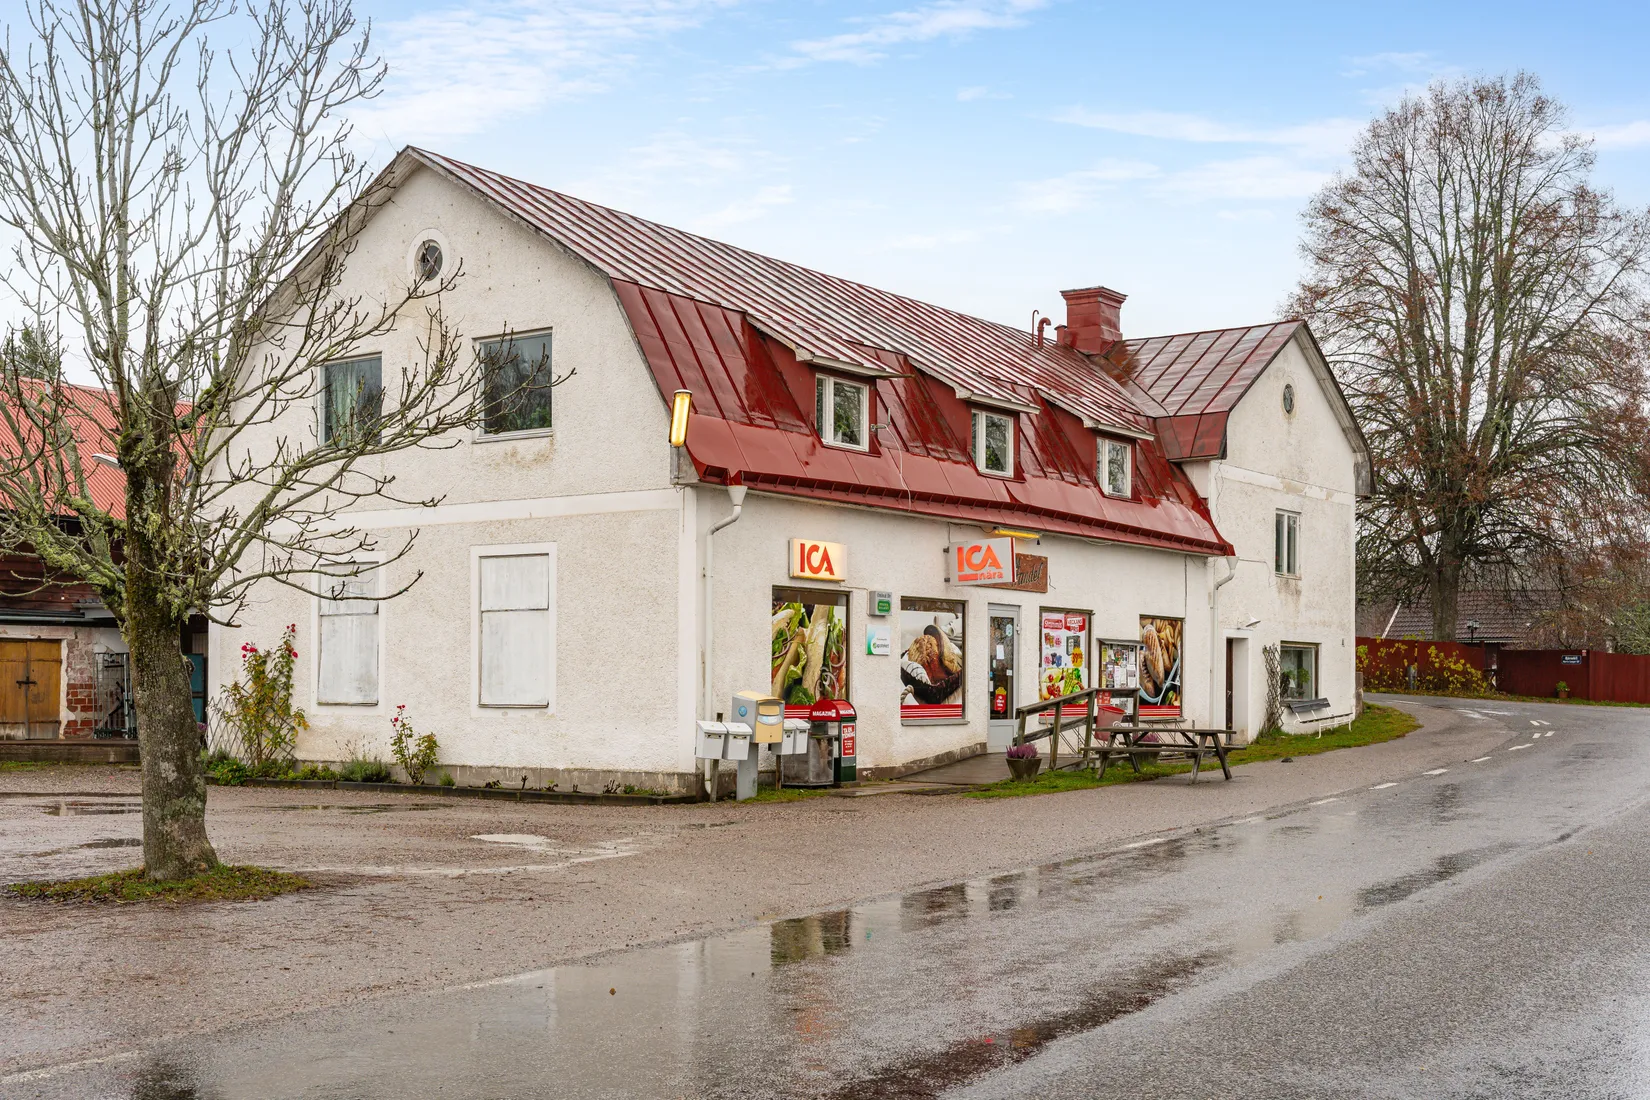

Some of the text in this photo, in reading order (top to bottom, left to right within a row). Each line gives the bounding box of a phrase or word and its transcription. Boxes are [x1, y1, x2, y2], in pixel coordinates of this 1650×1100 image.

[800, 543, 835, 576] ICA
[957, 544, 1003, 572] ICA
[979, 570, 1004, 580] nära
